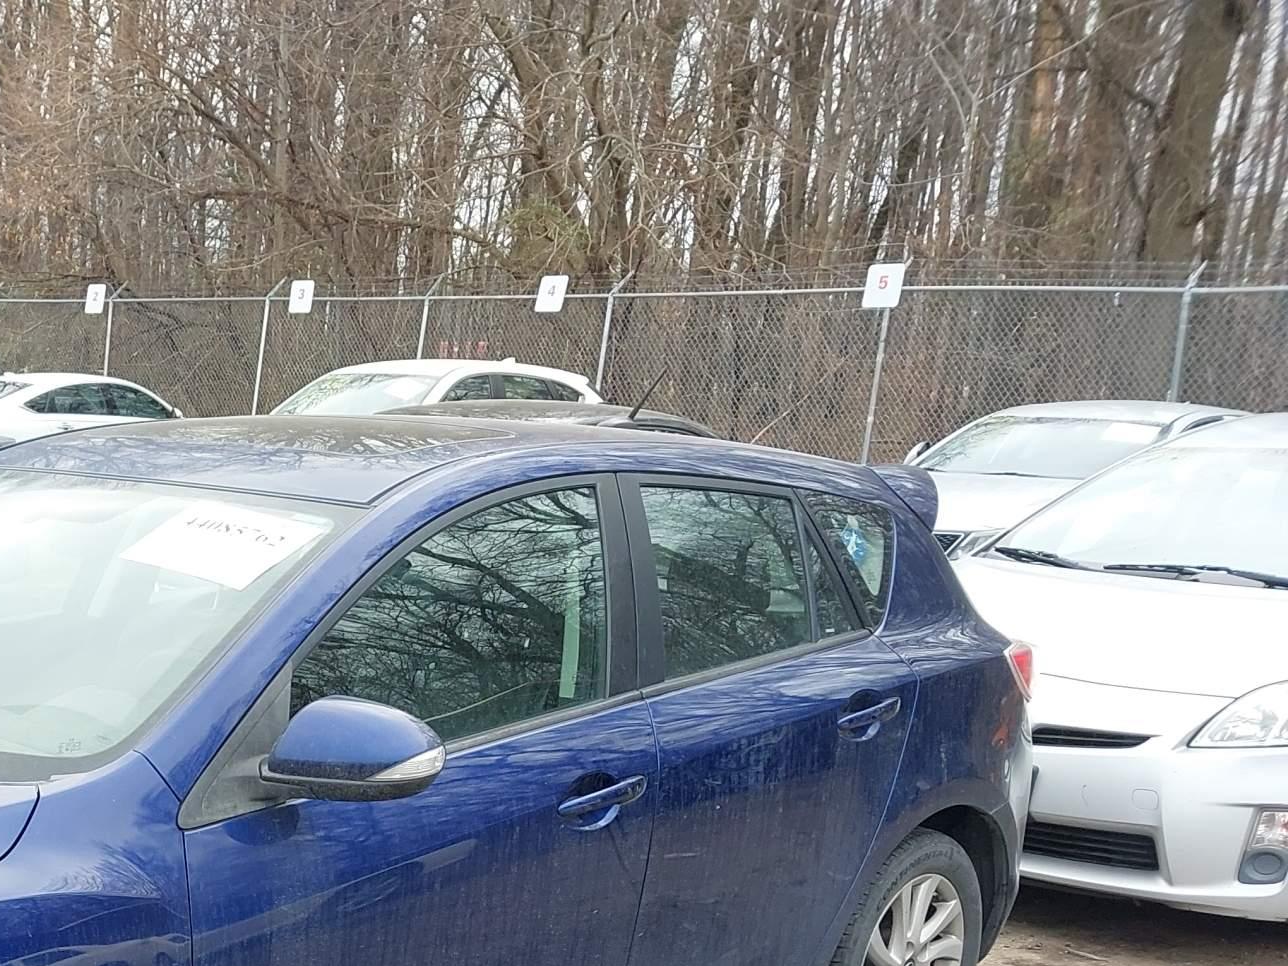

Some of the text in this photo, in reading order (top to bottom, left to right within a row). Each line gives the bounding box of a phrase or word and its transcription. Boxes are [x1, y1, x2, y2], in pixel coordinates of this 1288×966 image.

[878, 275, 889, 290] 5
[297, 288, 306, 300] 3
[547, 284, 557, 297] 4
